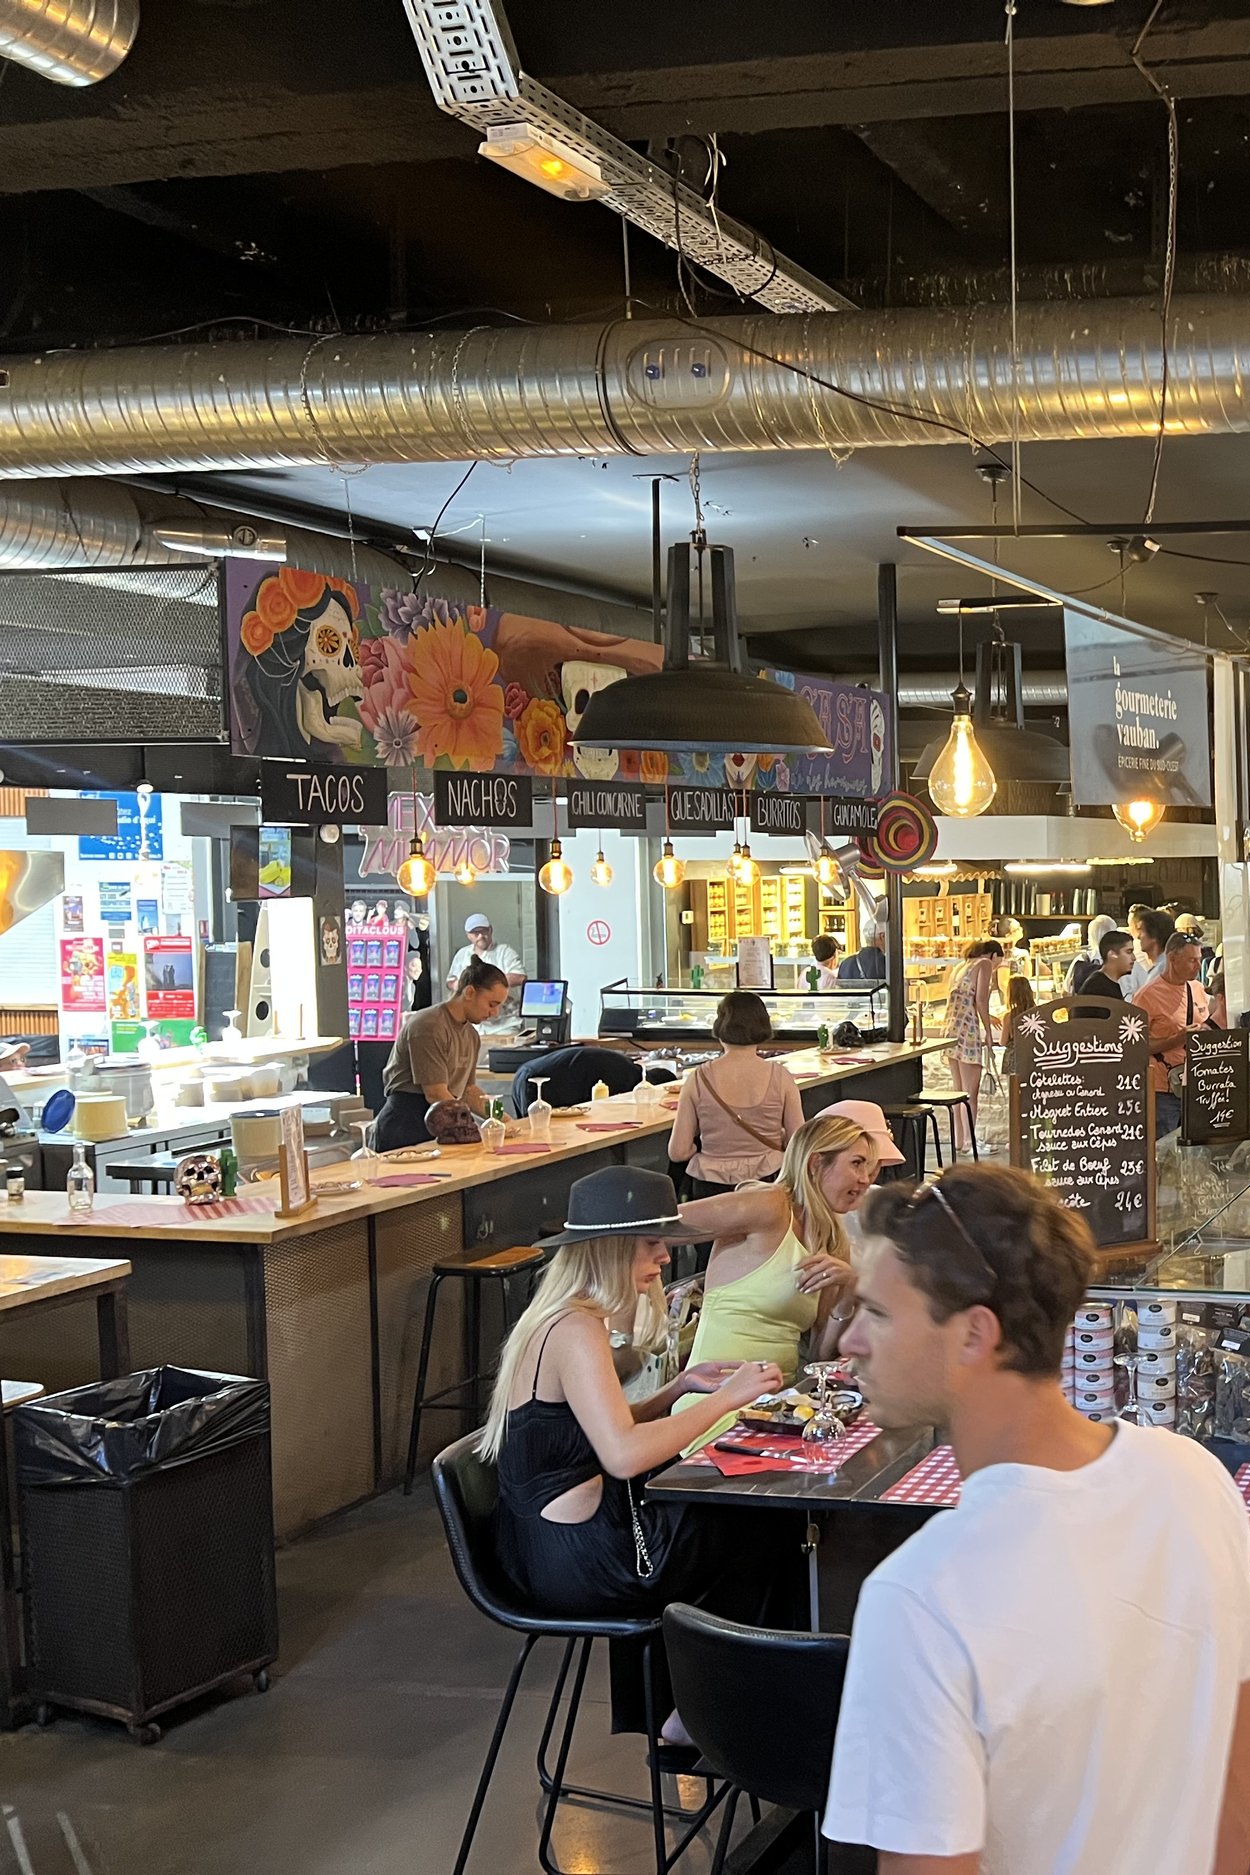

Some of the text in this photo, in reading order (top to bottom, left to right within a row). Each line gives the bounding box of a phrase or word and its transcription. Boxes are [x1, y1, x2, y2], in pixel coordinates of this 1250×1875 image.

[1113, 656, 1121, 676] la
[1114, 682, 1178, 721] gourmeterie
[1116, 717, 1160, 749] vauban.
[286, 774, 364, 813] TACOS
[448, 778, 517, 817] NACHOS
[671, 790, 734, 822] QUESADILLAS
[757, 797, 801, 830] BURRITOS
[1033, 1030, 1123, 1064] Suggestions
[1189, 1034, 1242, 1055] Suggestion
[1191, 1061, 1234, 1077] Tomates
[1116, 1074, 1141, 1090] 21€
[1198, 1075, 1237, 1091] Burrata
[1032, 1088, 1064, 1105] Agneau
[1076, 1085, 1105, 1097] Canard
[1030, 1099, 1142, 1124] Magret Entier 25€
[1030, 1122, 1144, 1140] Tournedos Canard 21€
[1035, 1136, 1118, 1153] sauce aux Cèpes
[1031, 1157, 1060, 1173] Filet
[1062, 1158, 1076, 1171] de
[1044, 1176, 1075, 1188] sauce
[1076, 1175, 1093, 1187] aux
[1115, 1191, 1143, 1212] 24€
